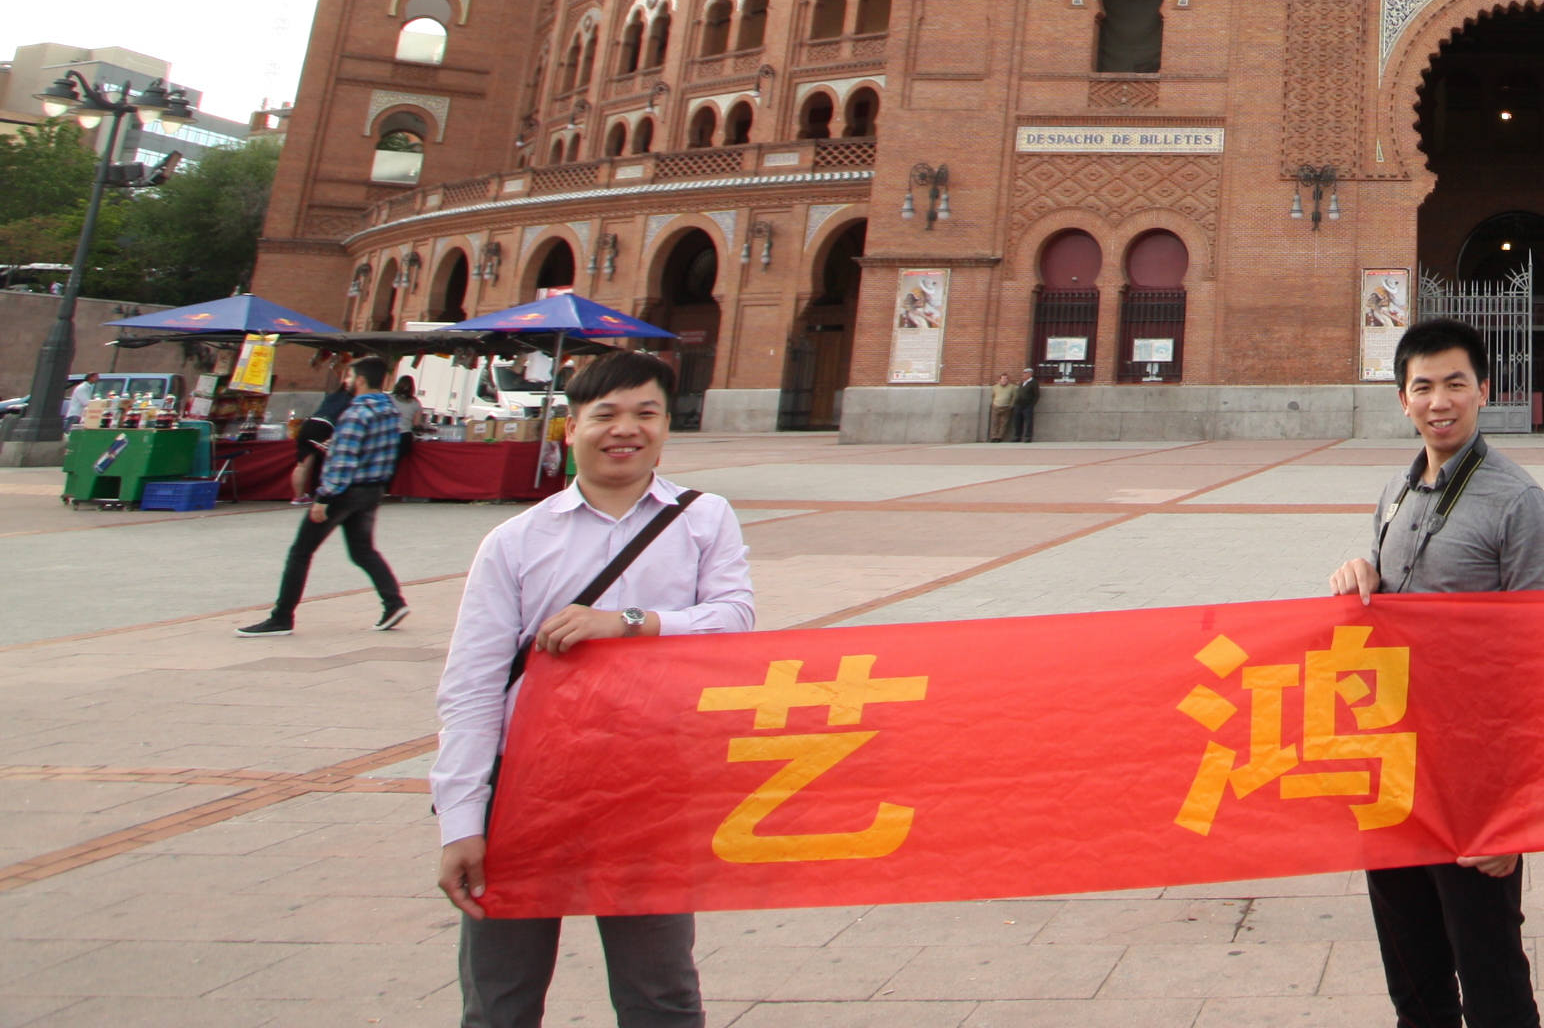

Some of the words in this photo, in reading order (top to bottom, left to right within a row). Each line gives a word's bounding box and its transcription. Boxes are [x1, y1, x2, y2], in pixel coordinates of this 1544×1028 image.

[1026, 133, 1104, 145] DESPACHO
[1111, 134, 1131, 145] DE
[1139, 134, 1213, 145] BILLETES
